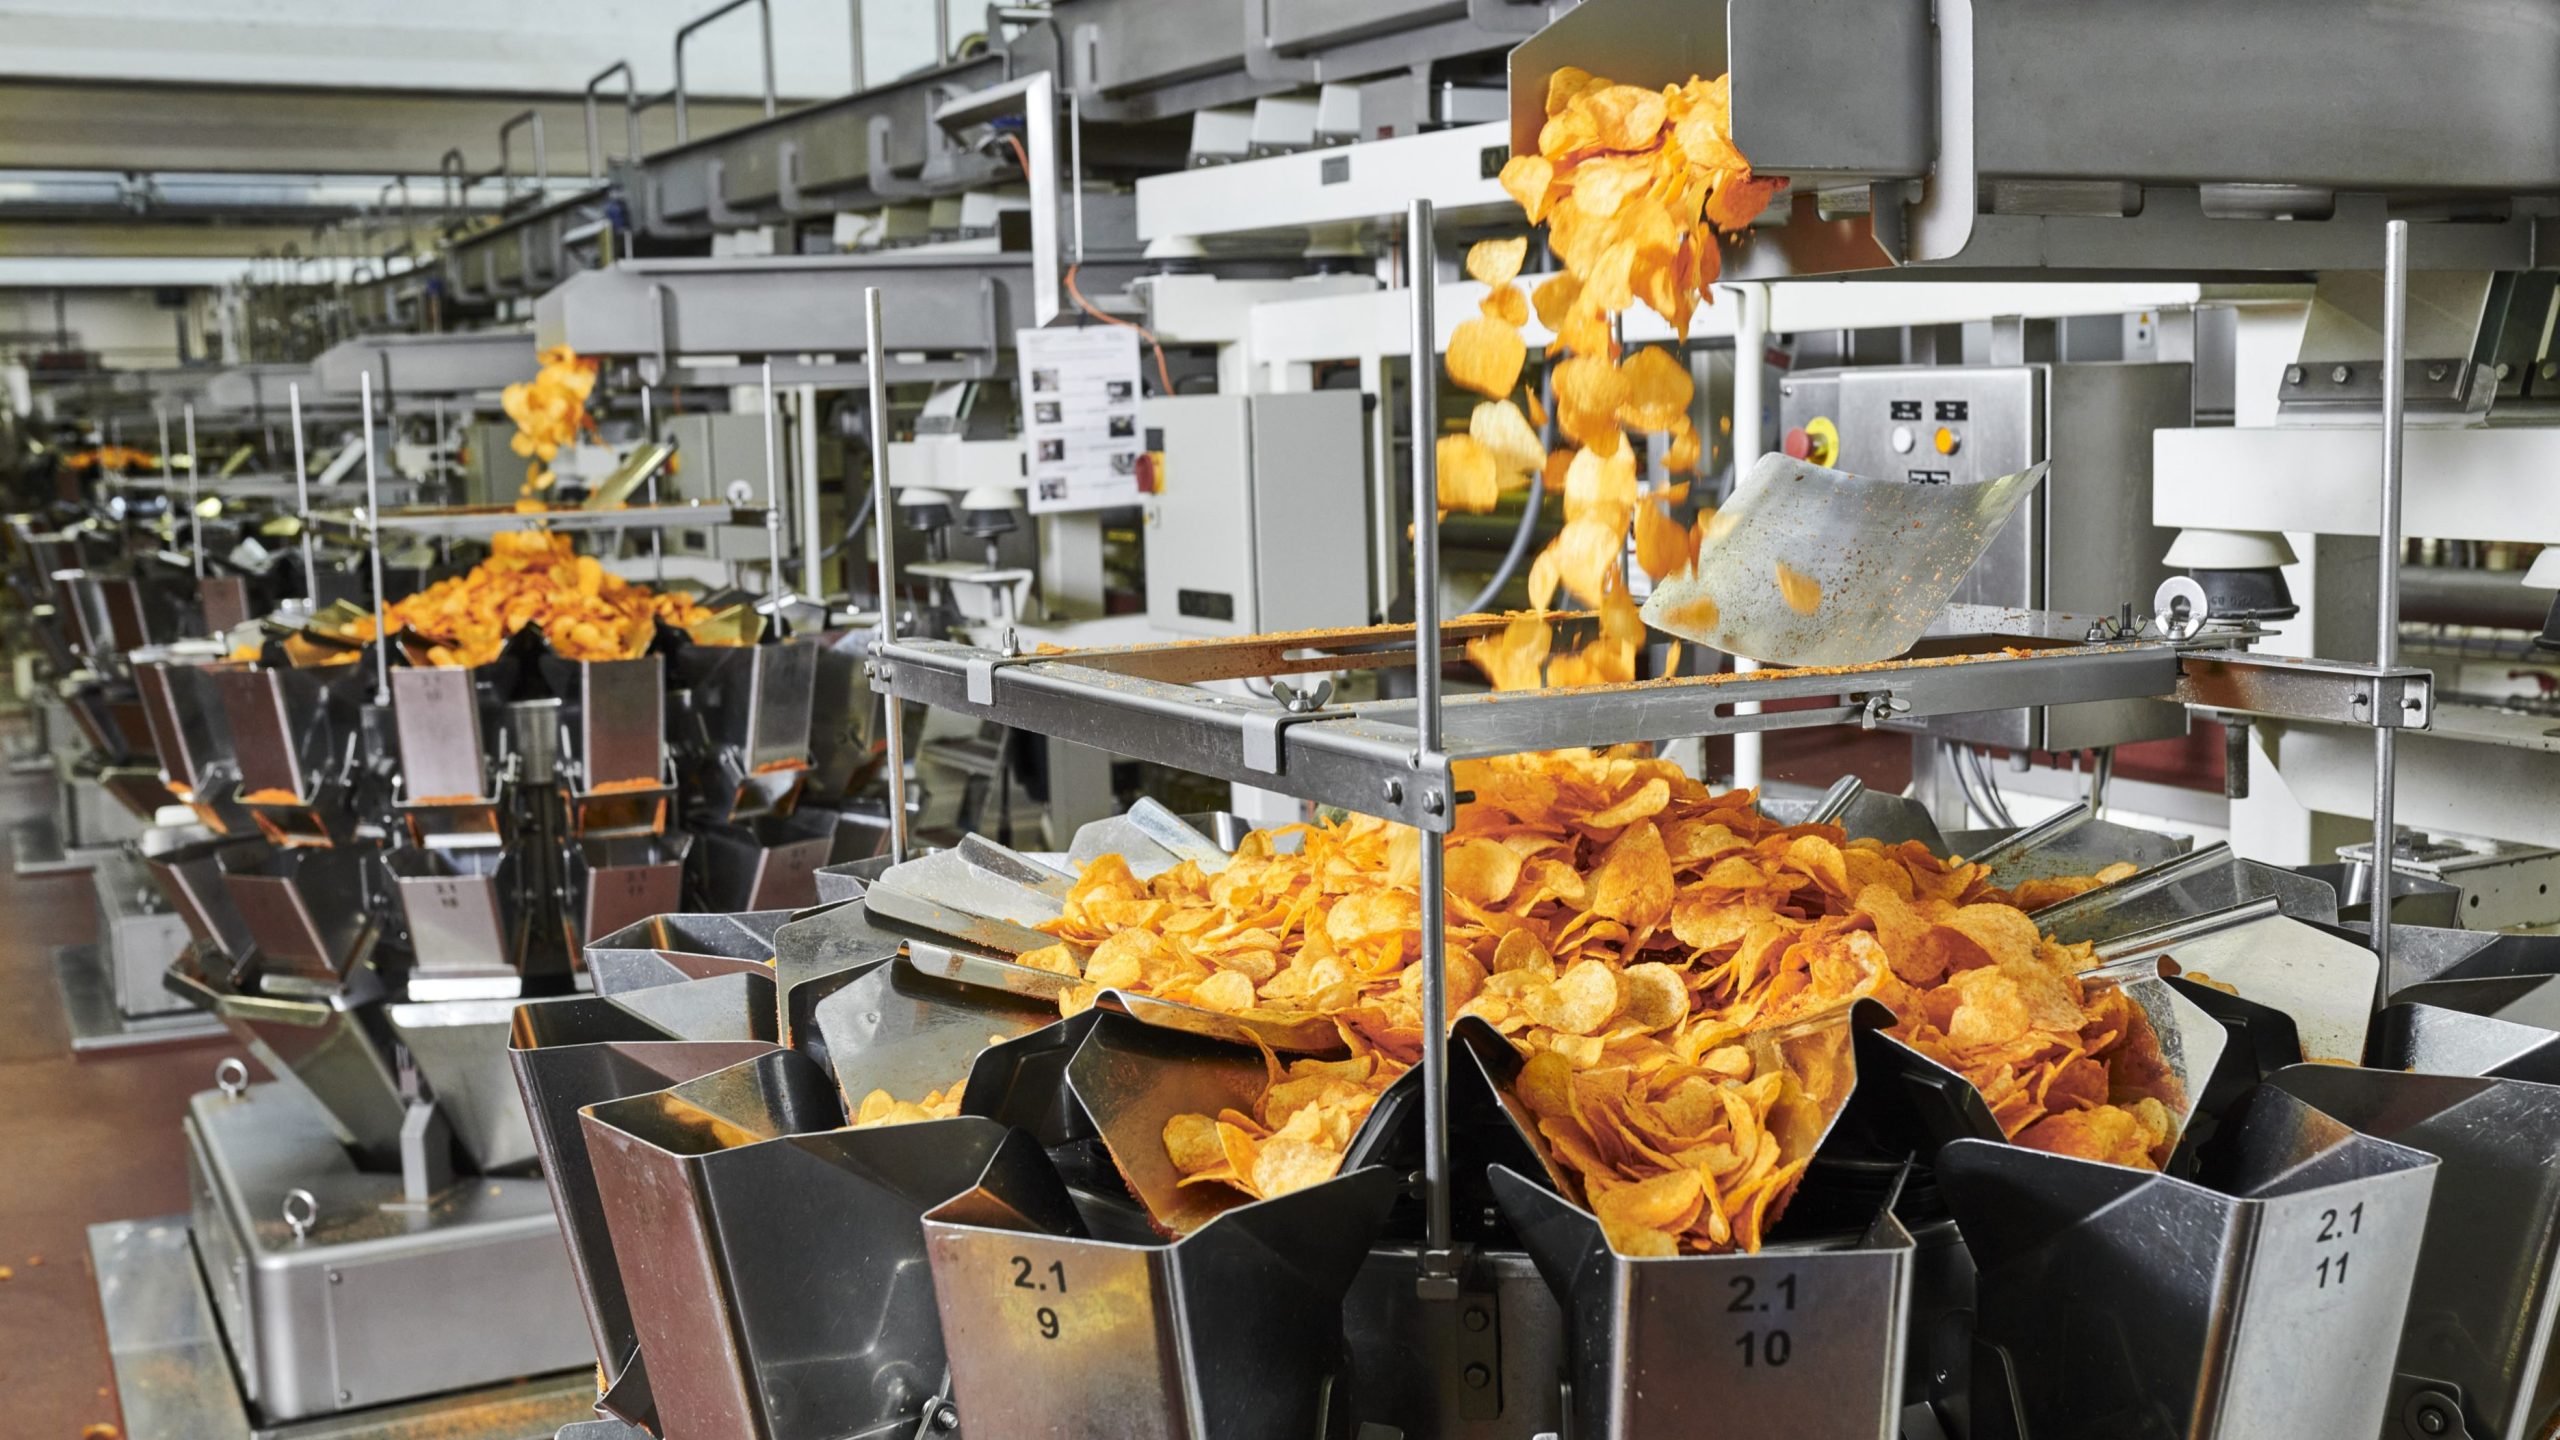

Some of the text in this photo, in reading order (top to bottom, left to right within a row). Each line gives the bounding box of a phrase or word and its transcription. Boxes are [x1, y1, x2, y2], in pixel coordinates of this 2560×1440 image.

[2316, 1201, 2364, 1243] 2.1
[1011, 1255, 1067, 1293] 2.1
[2316, 1251, 2350, 1288] 11
[1727, 1272, 1796, 1312] 2.1
[1036, 1306, 1060, 1340] 9
[1735, 1329, 1792, 1368] 10
